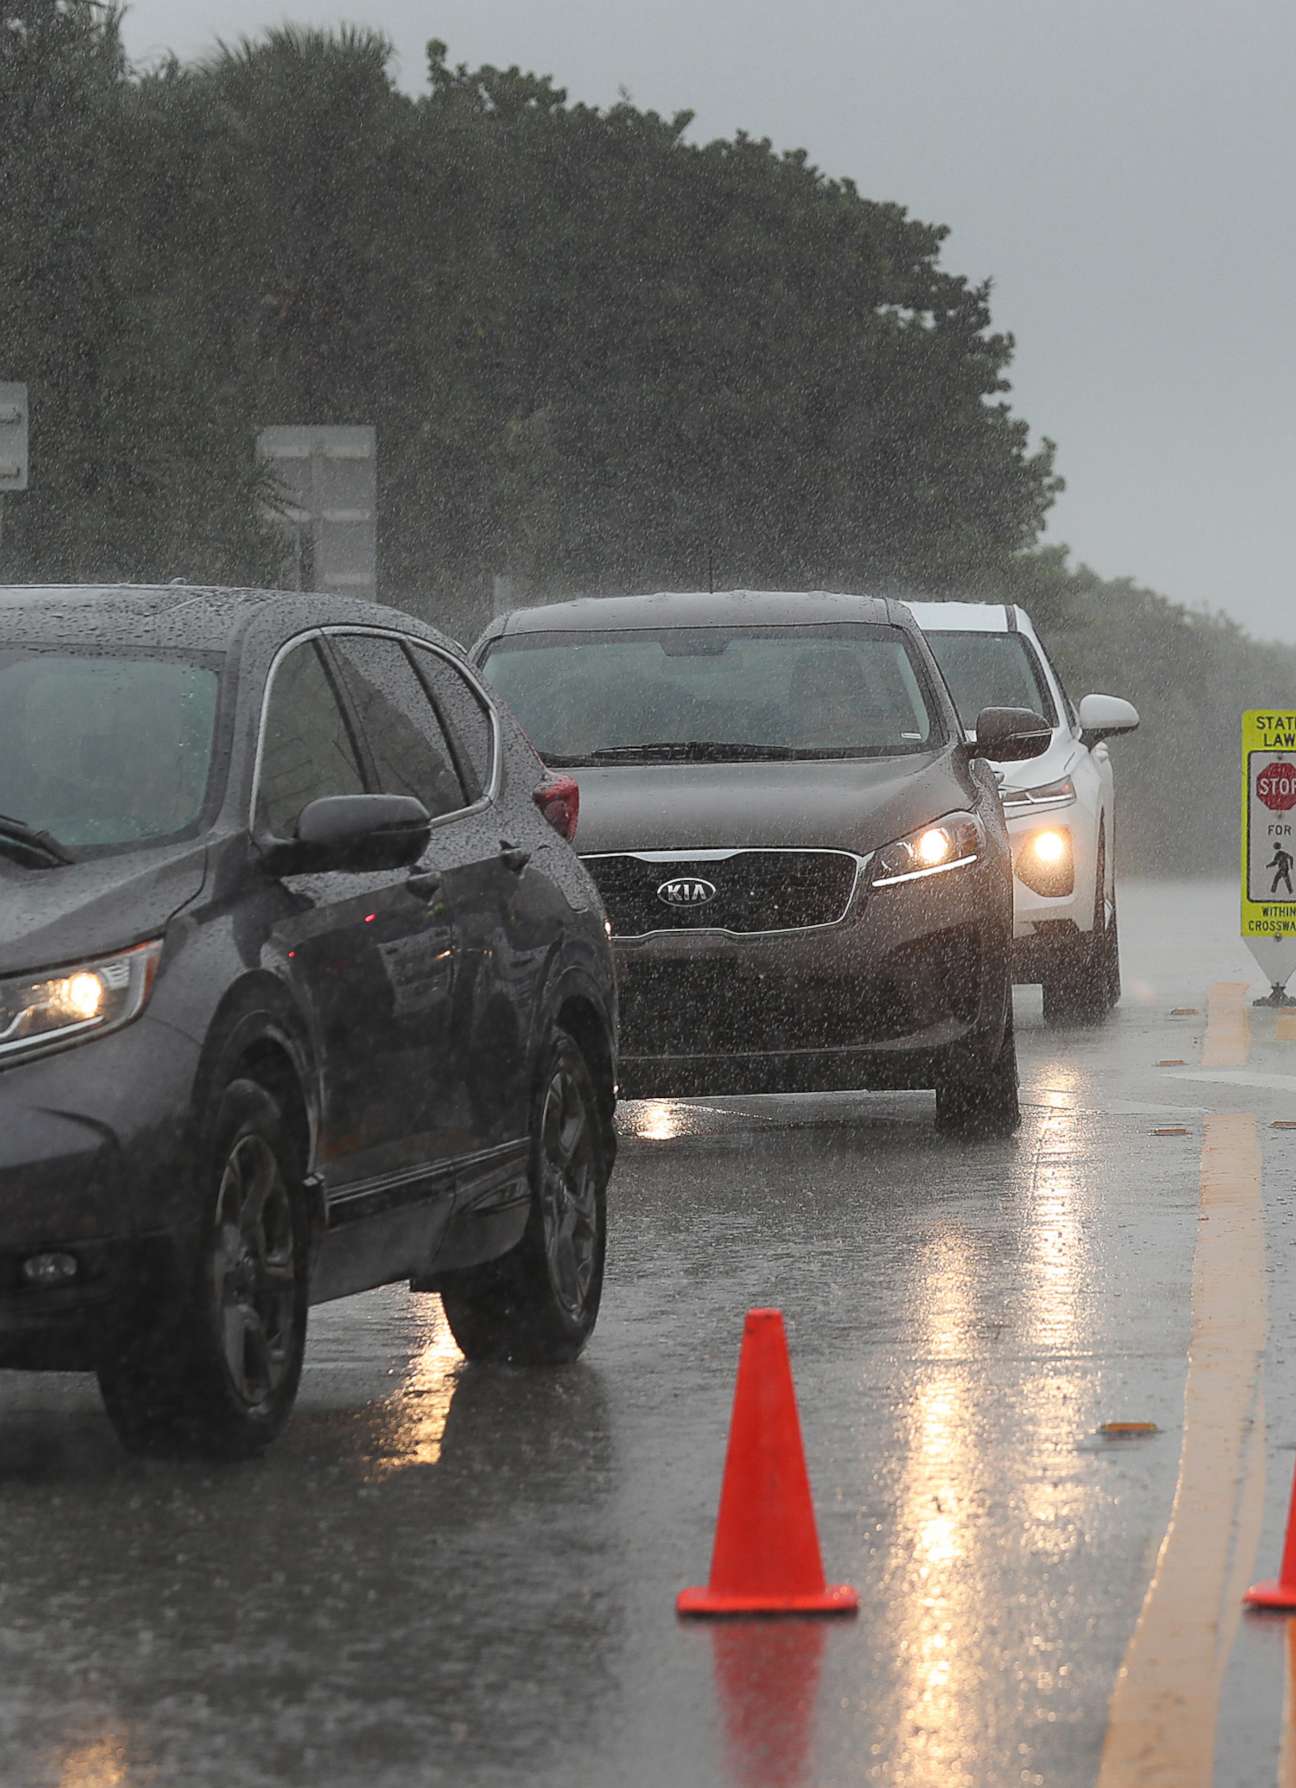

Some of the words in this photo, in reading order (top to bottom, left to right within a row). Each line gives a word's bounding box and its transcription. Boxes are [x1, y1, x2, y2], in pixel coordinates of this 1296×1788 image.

[1264, 733, 1295, 747] LAW
[1268, 824, 1291, 836] FOR
[667, 884, 707, 901] KIA
[1263, 907, 1296, 917] WITHIN
